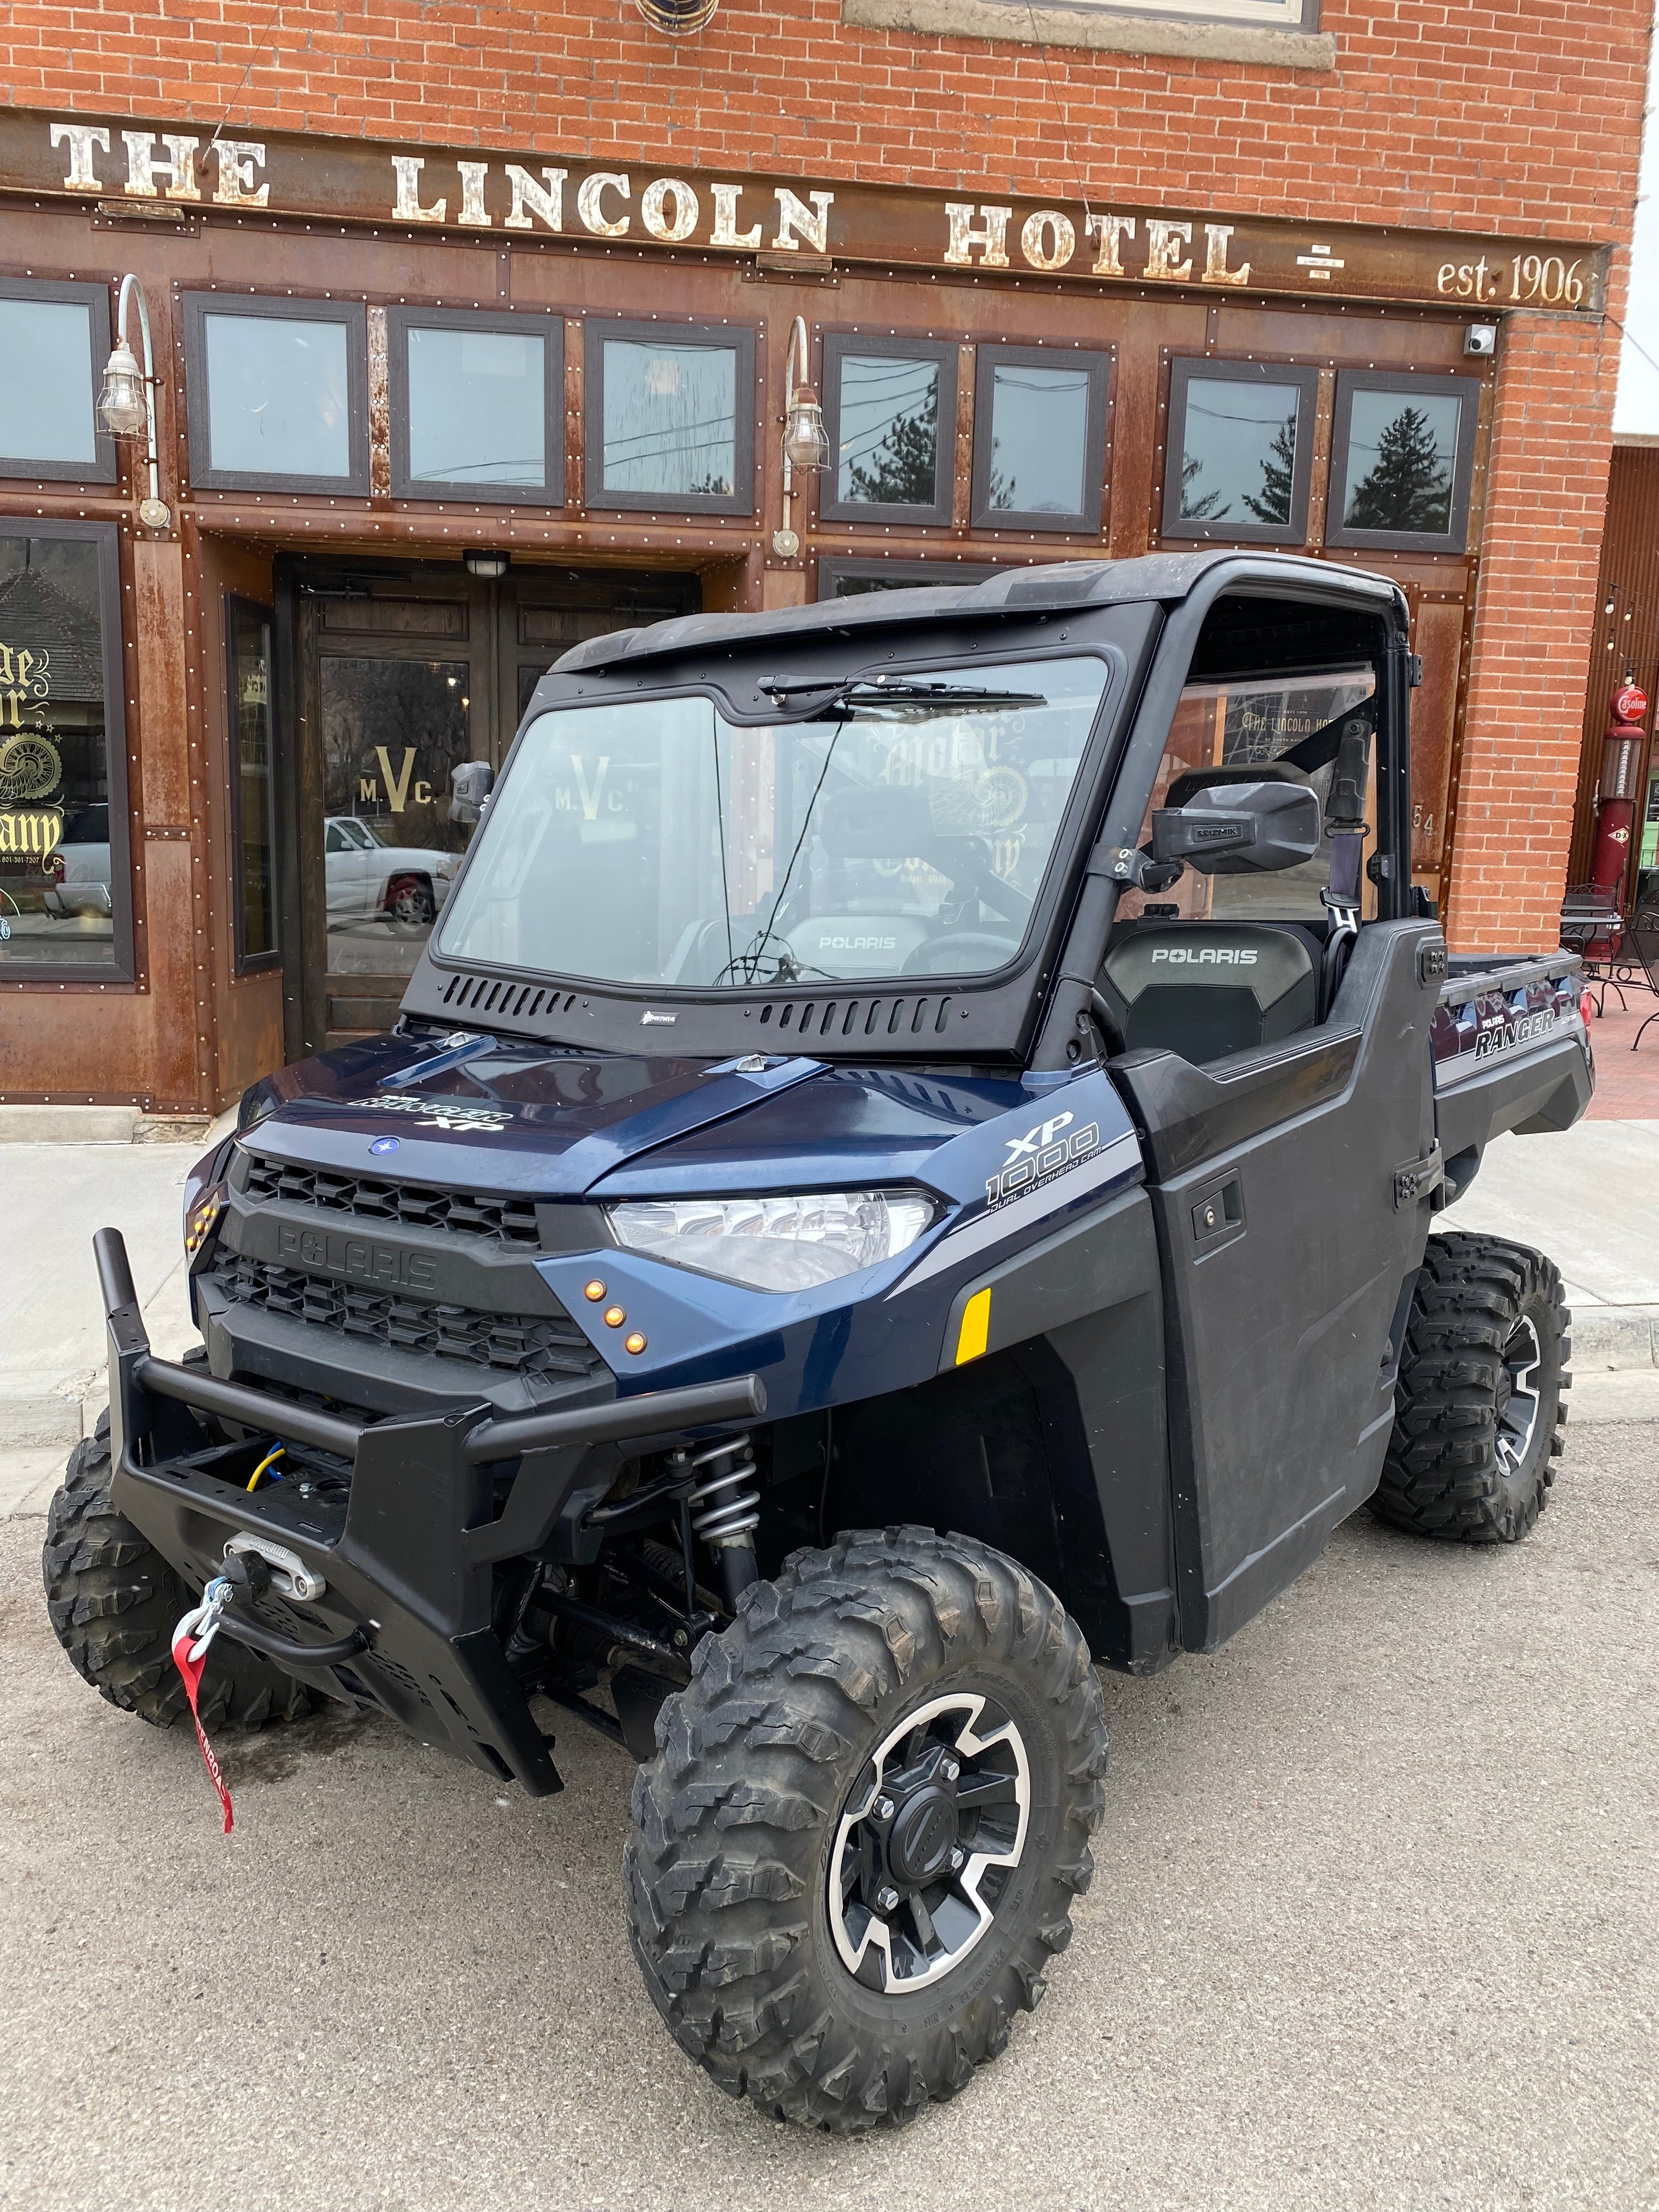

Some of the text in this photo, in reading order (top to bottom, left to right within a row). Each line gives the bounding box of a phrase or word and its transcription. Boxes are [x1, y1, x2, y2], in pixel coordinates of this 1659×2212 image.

[50, 123, 1251, 285] THE LINCOLN HOTEL
[1437, 255, 1584, 303] est. 1906
[1271, 717, 1311, 734] LINCOLN
[1197, 827, 1238, 837] SEIZMIK
[1413, 805, 1434, 837] 54
[819, 936, 896, 949] POLARIS
[1152, 949, 1258, 964] POLARIS
[1474, 1008, 1555, 1060] RANGER
[1482, 1014, 1505, 1029] POLARIS
[347, 1098, 514, 1122] RANGER
[414, 1116, 505, 1131] XP
[1002, 1110, 1075, 1167] XP
[985, 1121, 1100, 1205] 1000
[990, 1146, 1103, 1213] DUAL OVERHEAD CAM
[278, 1224, 437, 1290] POLARIS
